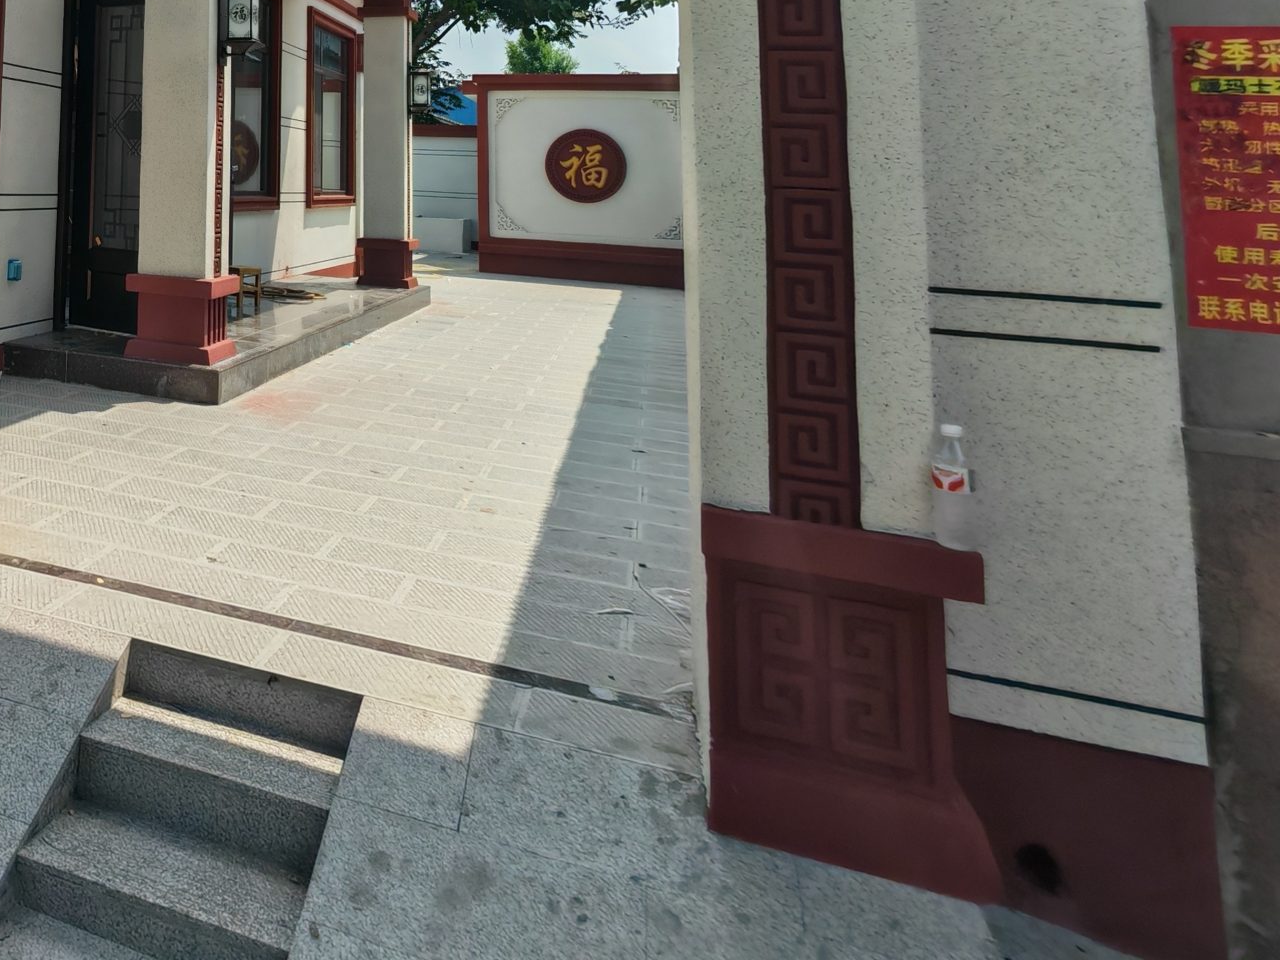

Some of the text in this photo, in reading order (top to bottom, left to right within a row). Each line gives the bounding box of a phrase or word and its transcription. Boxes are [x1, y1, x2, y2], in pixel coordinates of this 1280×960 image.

[231, 5, 248, 21] 福
[559, 143, 609, 189] 福
[1217, 273, 1280, 293] 一次
[1197, 295, 1280, 325] 联系电
